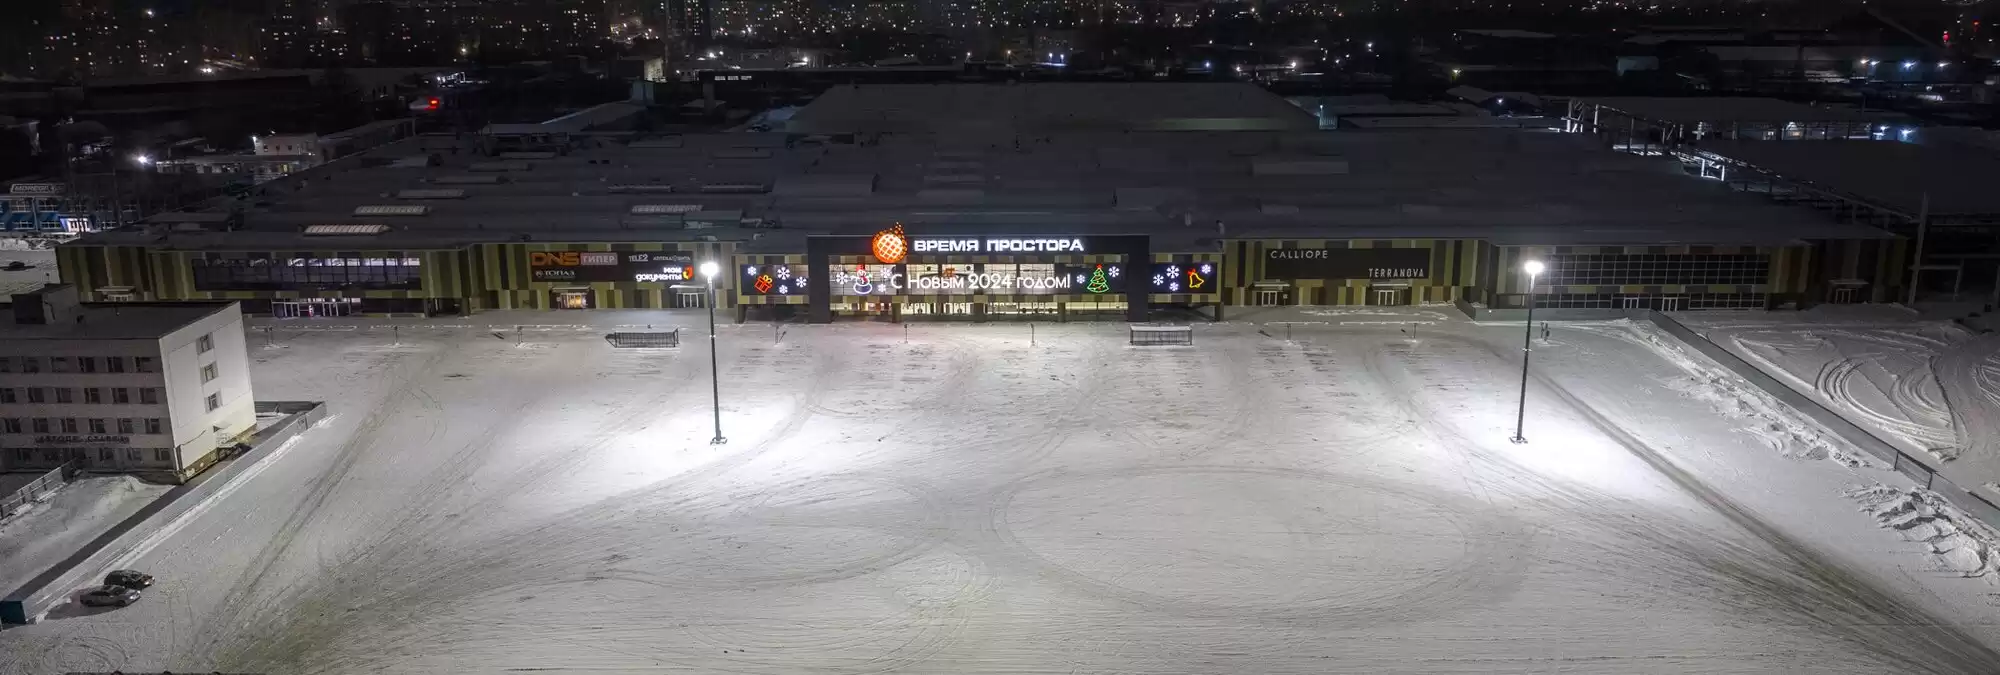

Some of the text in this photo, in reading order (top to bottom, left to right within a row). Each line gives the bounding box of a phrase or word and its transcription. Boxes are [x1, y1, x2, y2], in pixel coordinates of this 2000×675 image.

[914, 239, 1084, 252] ВРЕМЯ ПРОСТОРА
[531, 252, 580, 266] DNS
[583, 255, 615, 264] ГИПЕР
[1270, 249, 1329, 259] CALLIOPE
[1368, 267, 1425, 278] TERRANOVA
[891, 275, 903, 289] С
[968, 273, 1013, 289] 2024
